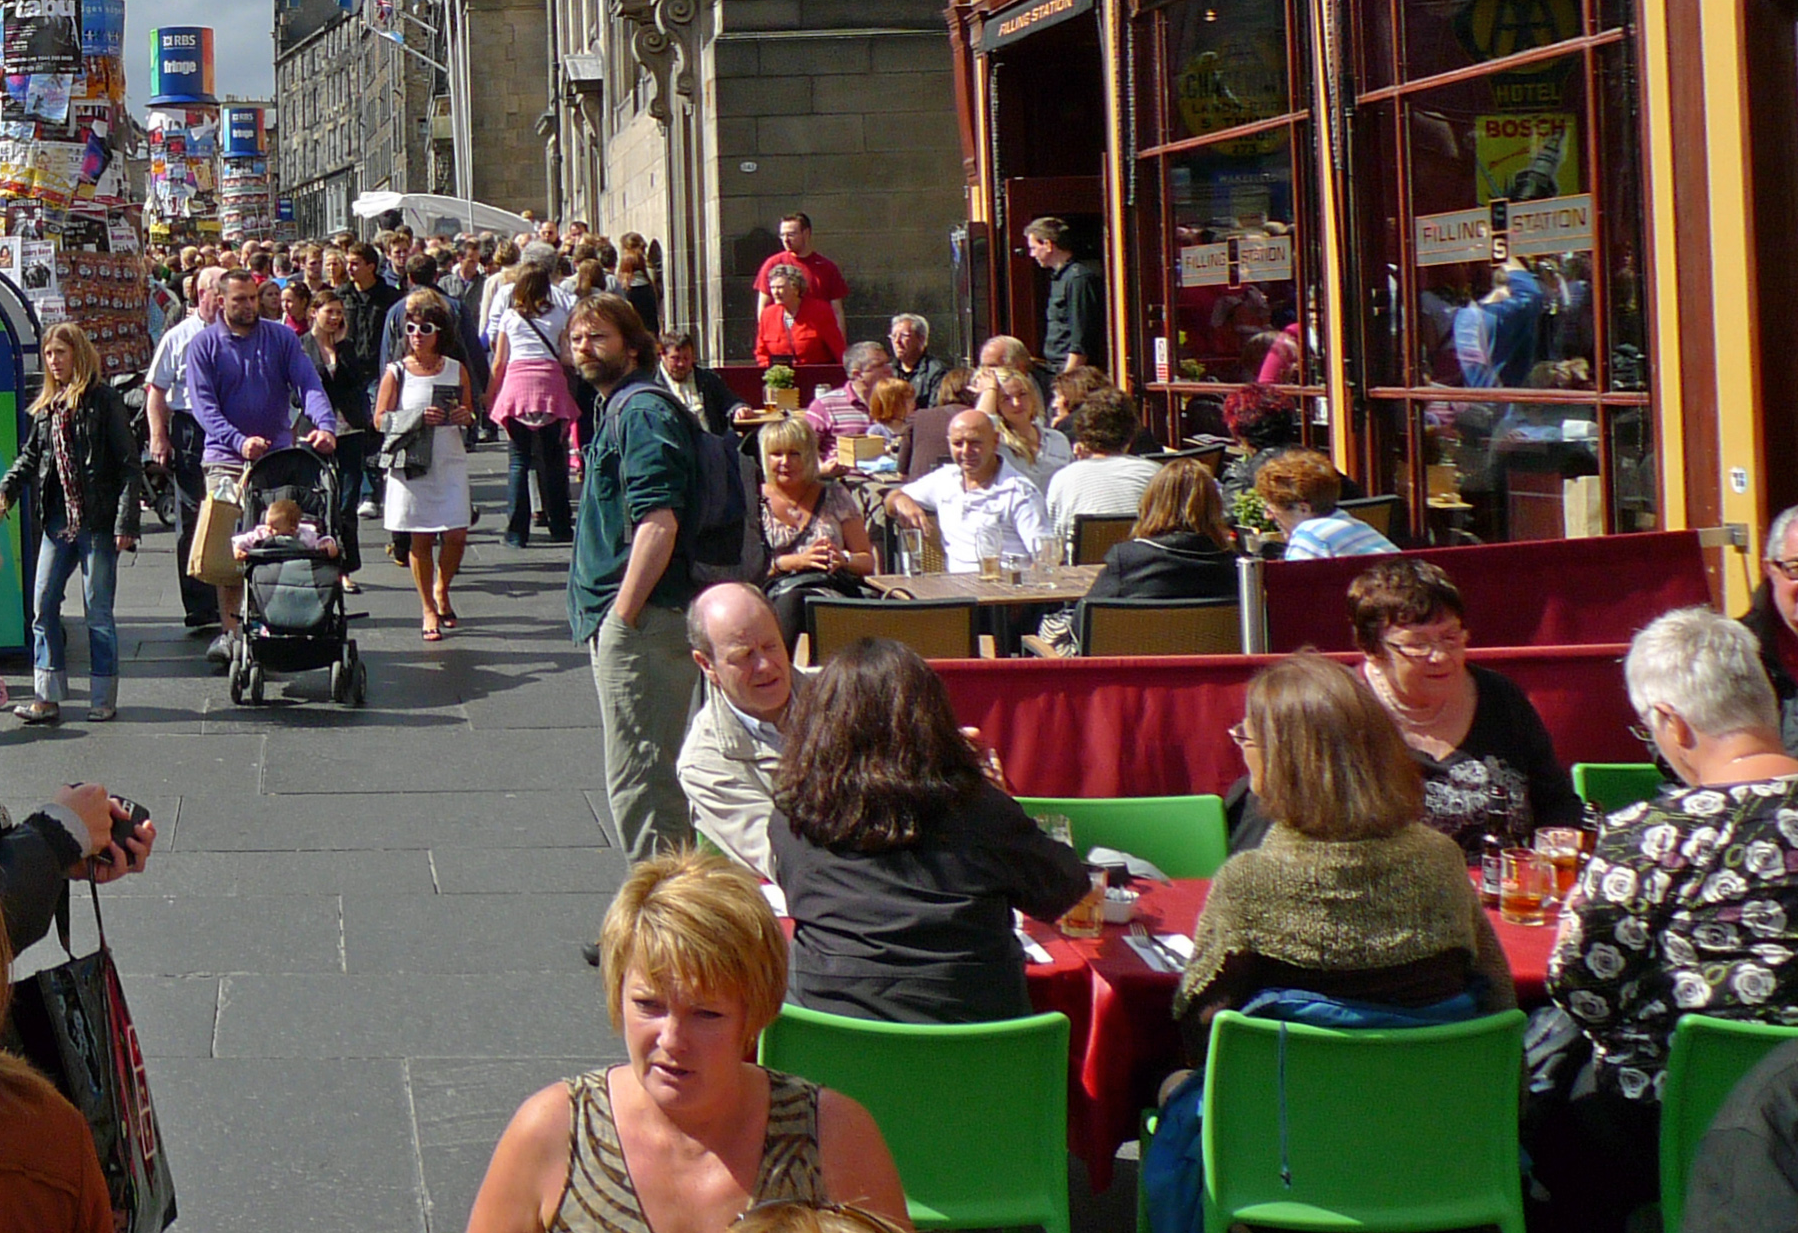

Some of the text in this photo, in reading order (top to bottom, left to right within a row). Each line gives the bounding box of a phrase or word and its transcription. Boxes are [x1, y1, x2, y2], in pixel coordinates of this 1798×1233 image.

[998, 11, 1031, 37] FILLING
[174, 35, 196, 46] RBS
[164, 60, 197, 75] fringe
[1497, 84, 1561, 102] HOTEL
[1485, 118, 1566, 139] BOSCH
[1423, 219, 1488, 243] FILLING
[1512, 207, 1587, 234] STATION
[1185, 246, 1286, 268] FILLING STATION
